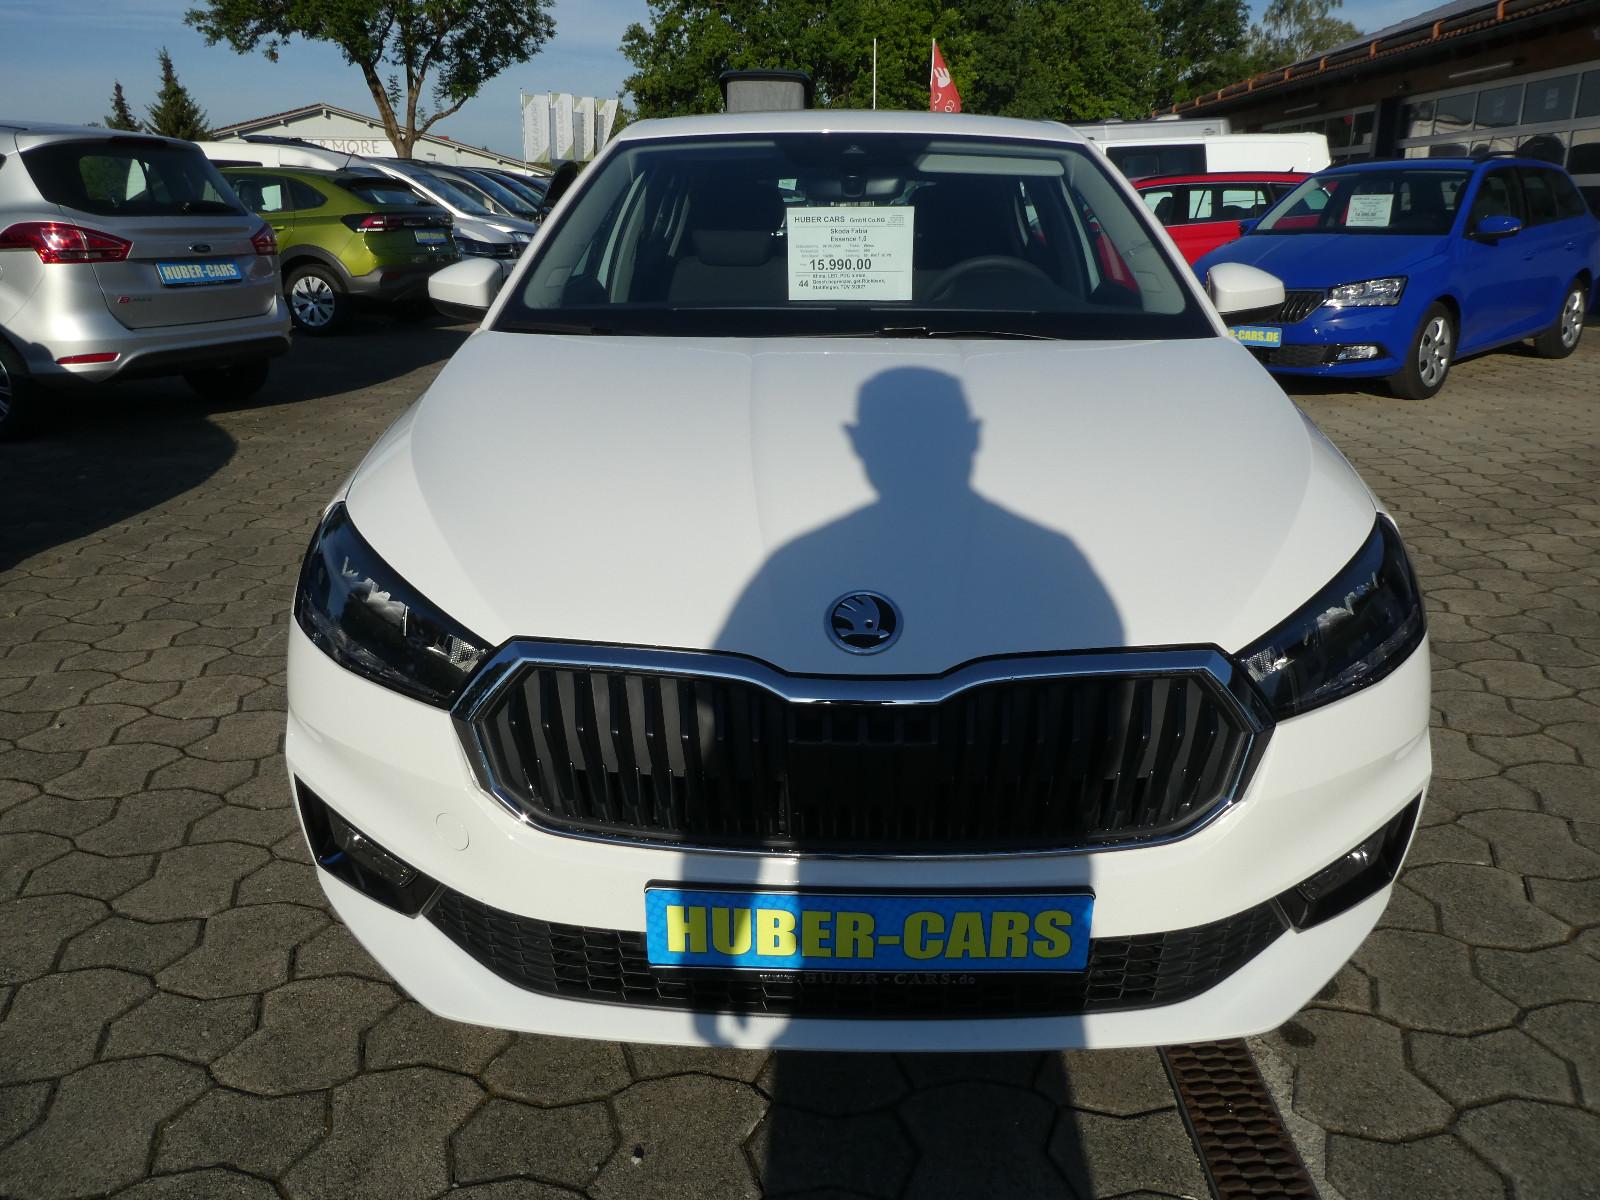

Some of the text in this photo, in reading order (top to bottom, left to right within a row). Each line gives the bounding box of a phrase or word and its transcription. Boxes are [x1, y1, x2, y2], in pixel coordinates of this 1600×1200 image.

[332, 140, 381, 154] MORE
[162, 263, 237, 280] HUBER-CARS
[798, 280, 809, 288] 44
[665, 904, 1073, 960] HUBER-CARS
